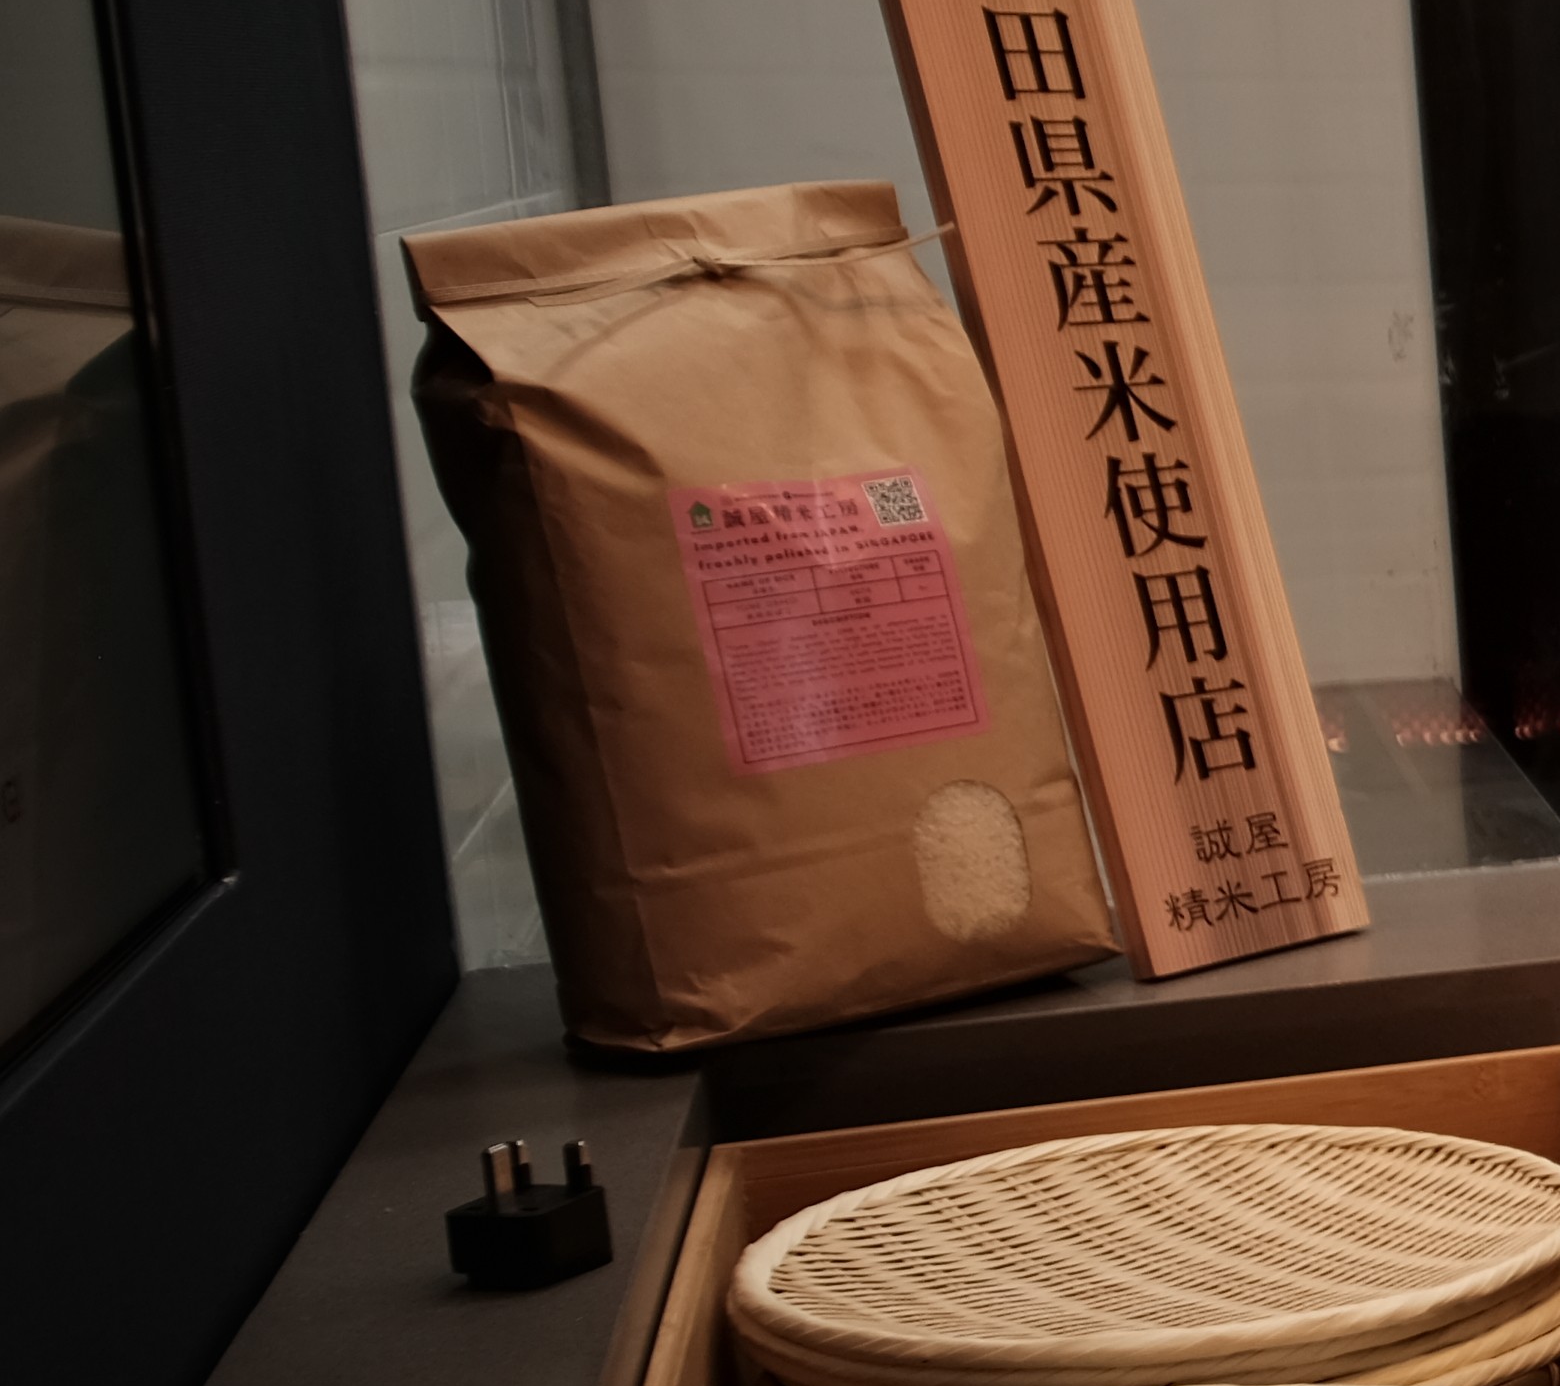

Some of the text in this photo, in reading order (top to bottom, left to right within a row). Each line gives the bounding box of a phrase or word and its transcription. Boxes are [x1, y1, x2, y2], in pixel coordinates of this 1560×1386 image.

[855, 530, 935, 549] SINGAPORE
[1189, 811, 1291, 864] 誠屋
[1163, 858, 1342, 934] 精米工房
